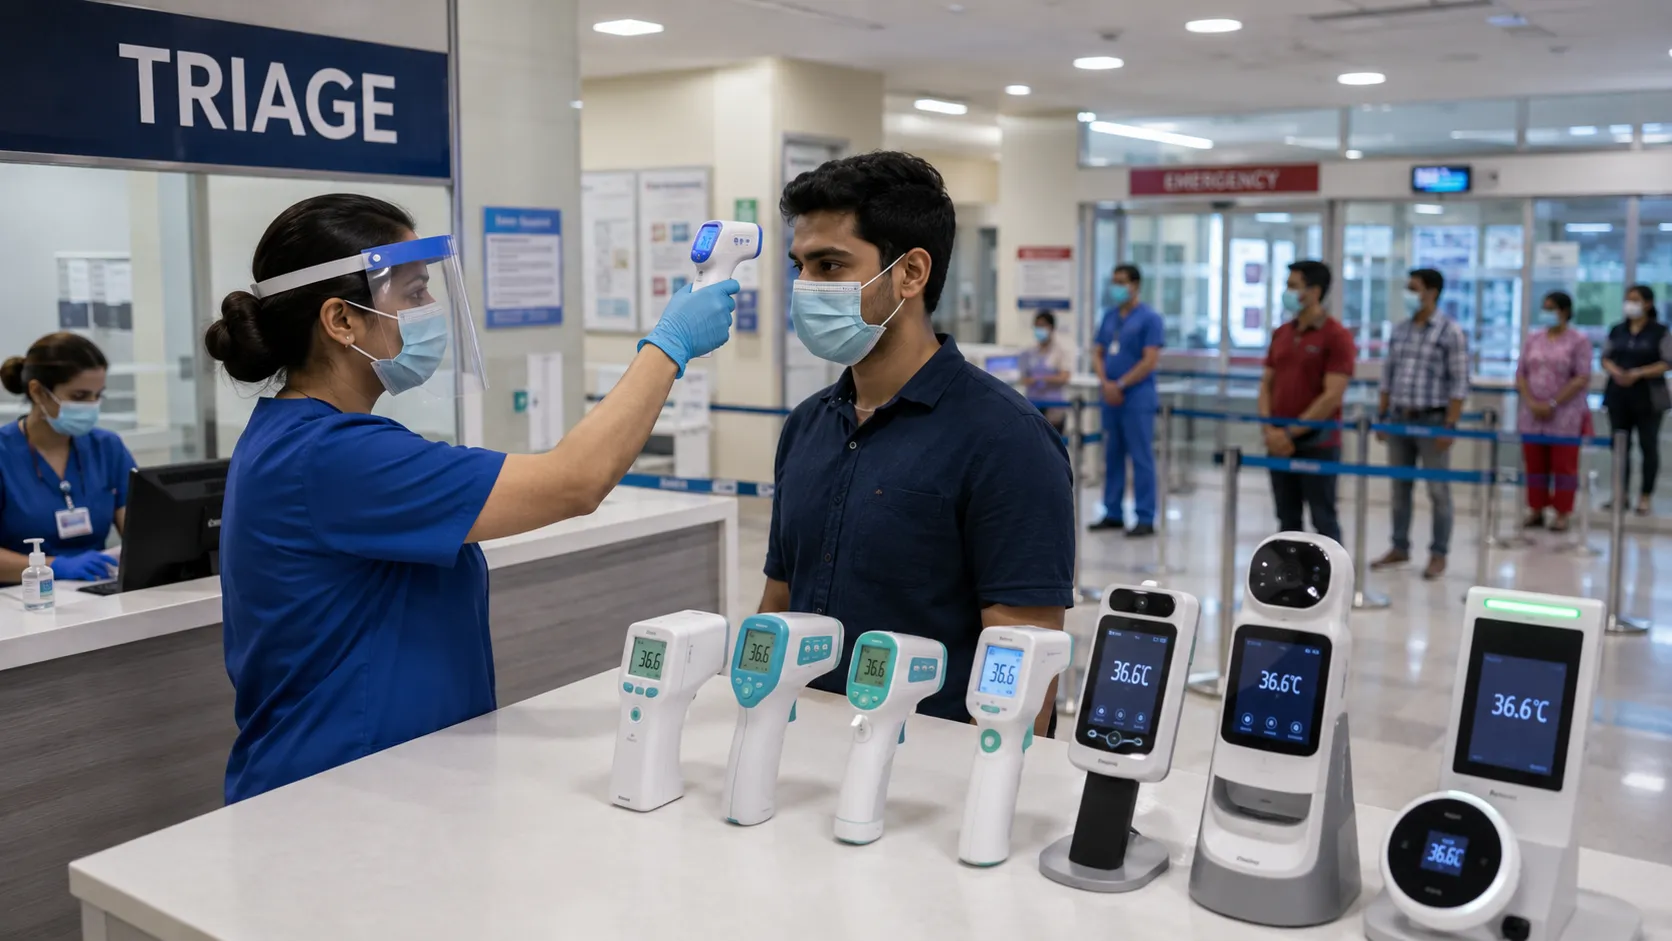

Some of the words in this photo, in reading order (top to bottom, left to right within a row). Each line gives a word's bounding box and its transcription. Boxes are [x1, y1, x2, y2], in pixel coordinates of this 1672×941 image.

[118, 43, 397, 144] TRIAGE
[1163, 168, 1279, 192] EMERGENCY
[639, 650, 661, 670] 36.6
[749, 643, 771, 663] 36.6
[864, 658, 886, 678] 36.6
[989, 663, 1016, 685] 36.6
[1258, 670, 1302, 695] 36.6°C
[1491, 693, 1549, 723] 36.6°C
